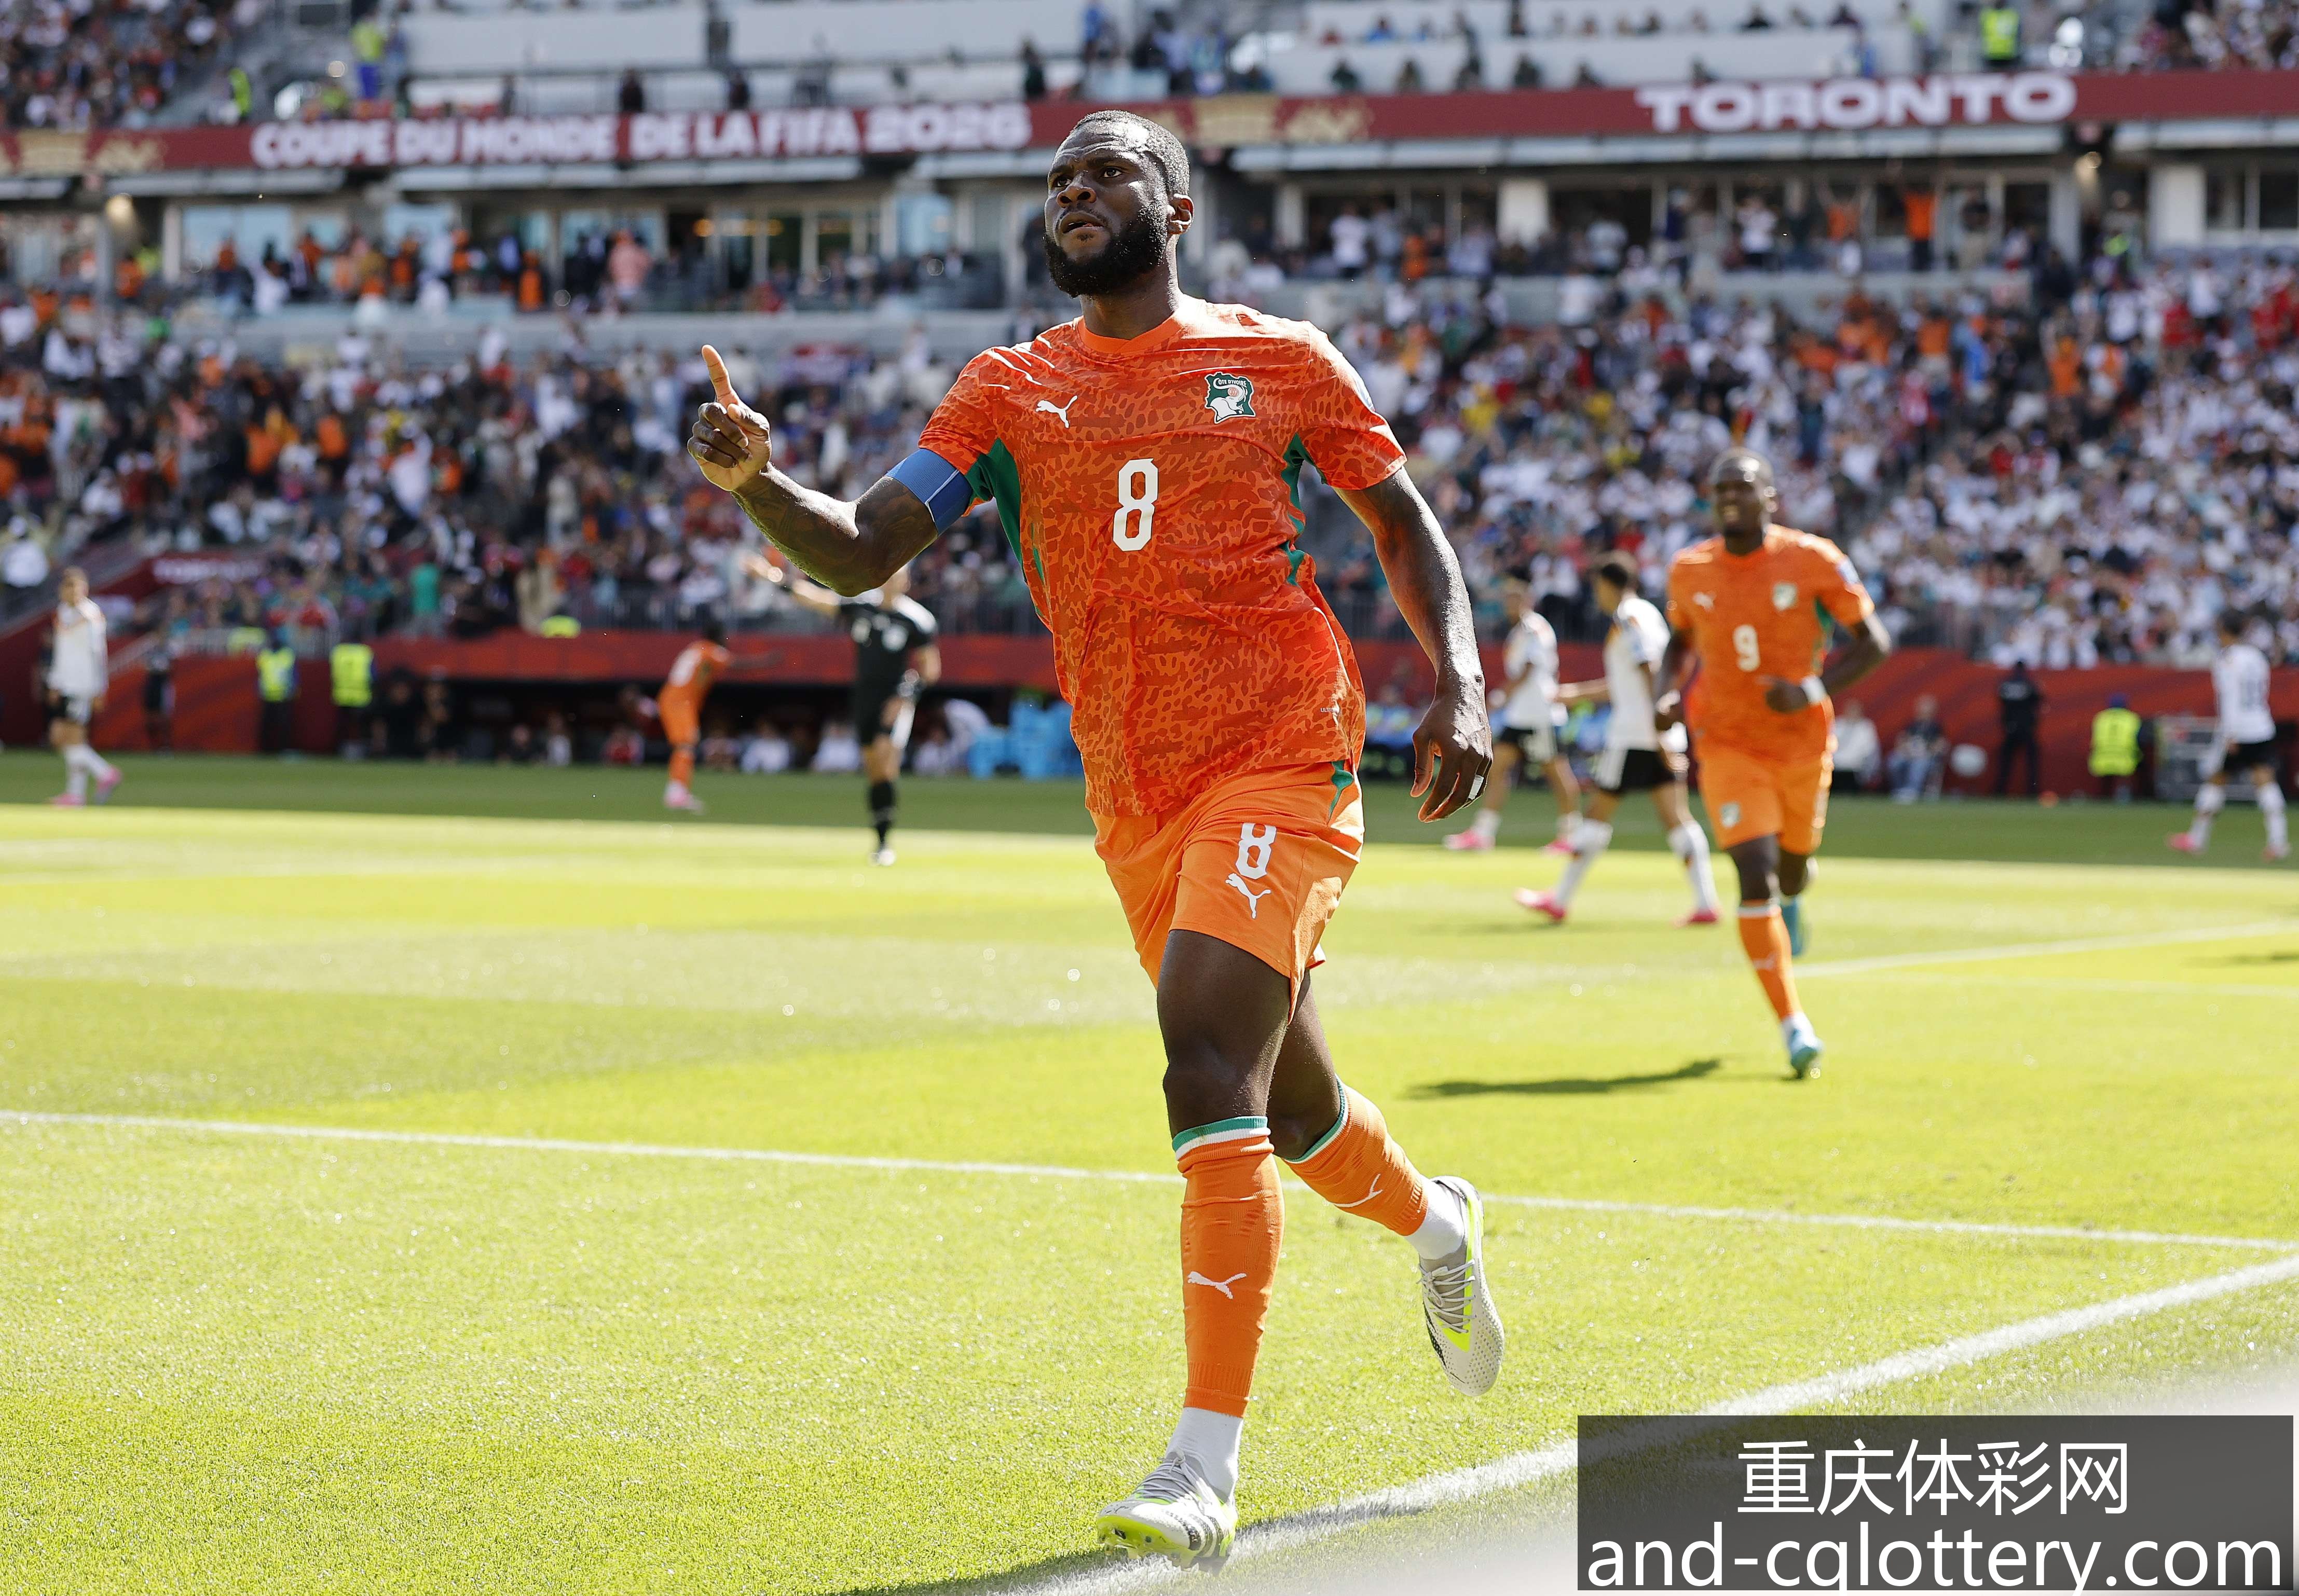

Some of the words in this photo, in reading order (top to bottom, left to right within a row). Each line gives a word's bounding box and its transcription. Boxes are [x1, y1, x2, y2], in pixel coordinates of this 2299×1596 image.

[1634, 72, 2076, 133] TORONTO
[250, 119, 390, 169] COUPE
[395, 117, 458, 164] DU
[462, 115, 617, 163] MONDE
[628, 111, 692, 160] DE
[694, 108, 759, 157] LA
[760, 106, 861, 157] FIFA
[864, 102, 1032, 153] 2026
[1113, 458, 1158, 552] 8
[1733, 625, 1760, 671] 9
[1236, 823, 1277, 879] 8
